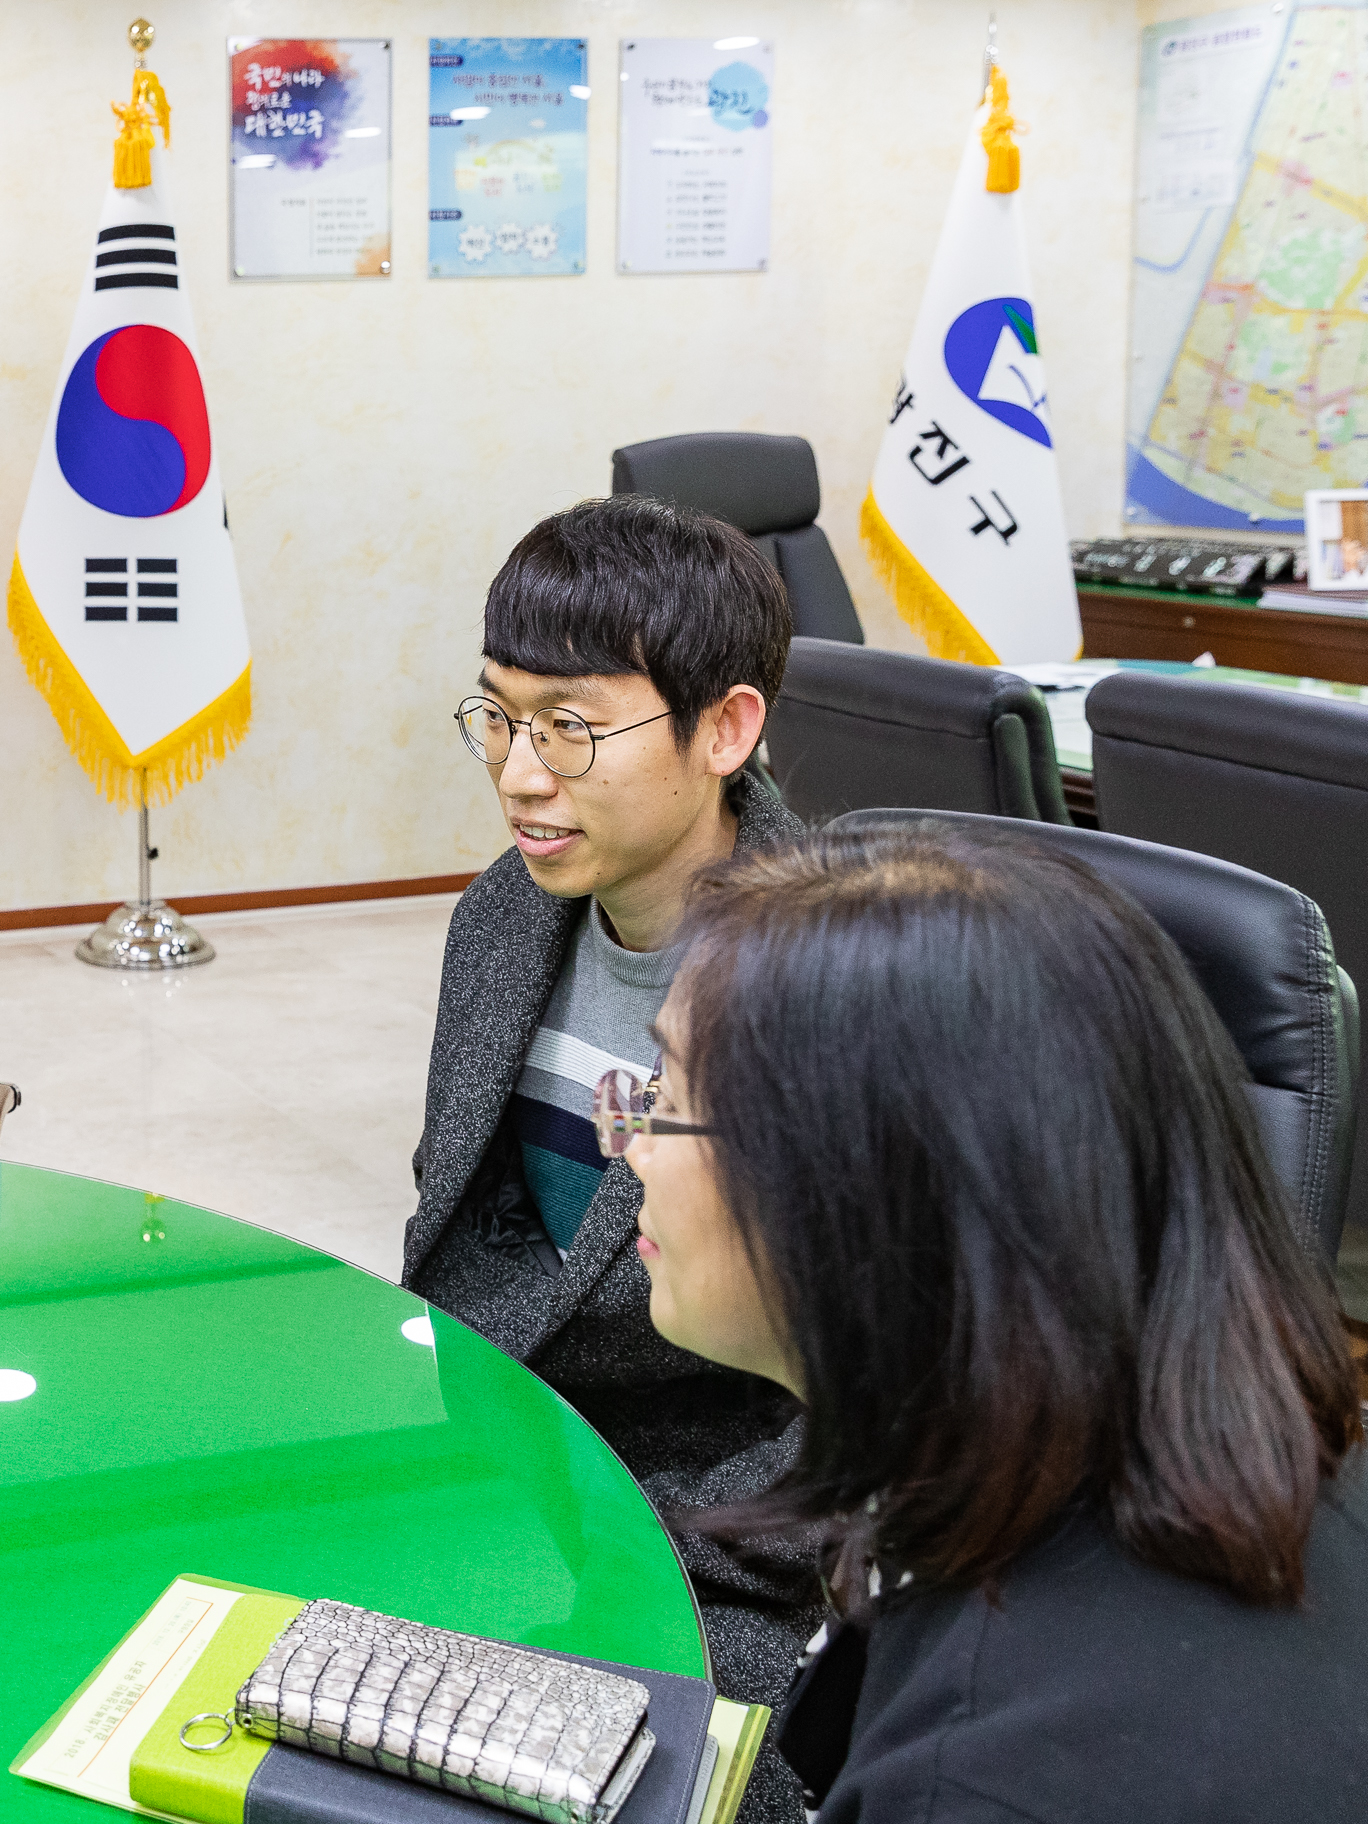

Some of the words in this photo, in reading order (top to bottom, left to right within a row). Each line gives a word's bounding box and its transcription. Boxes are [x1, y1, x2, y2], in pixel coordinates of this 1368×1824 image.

[244, 109, 326, 139] 대한민국
[123, 1659, 147, 1682] 유공자
[96, 1714, 121, 1742] 감사패
[117, 1684, 146, 1715] 전달행사
